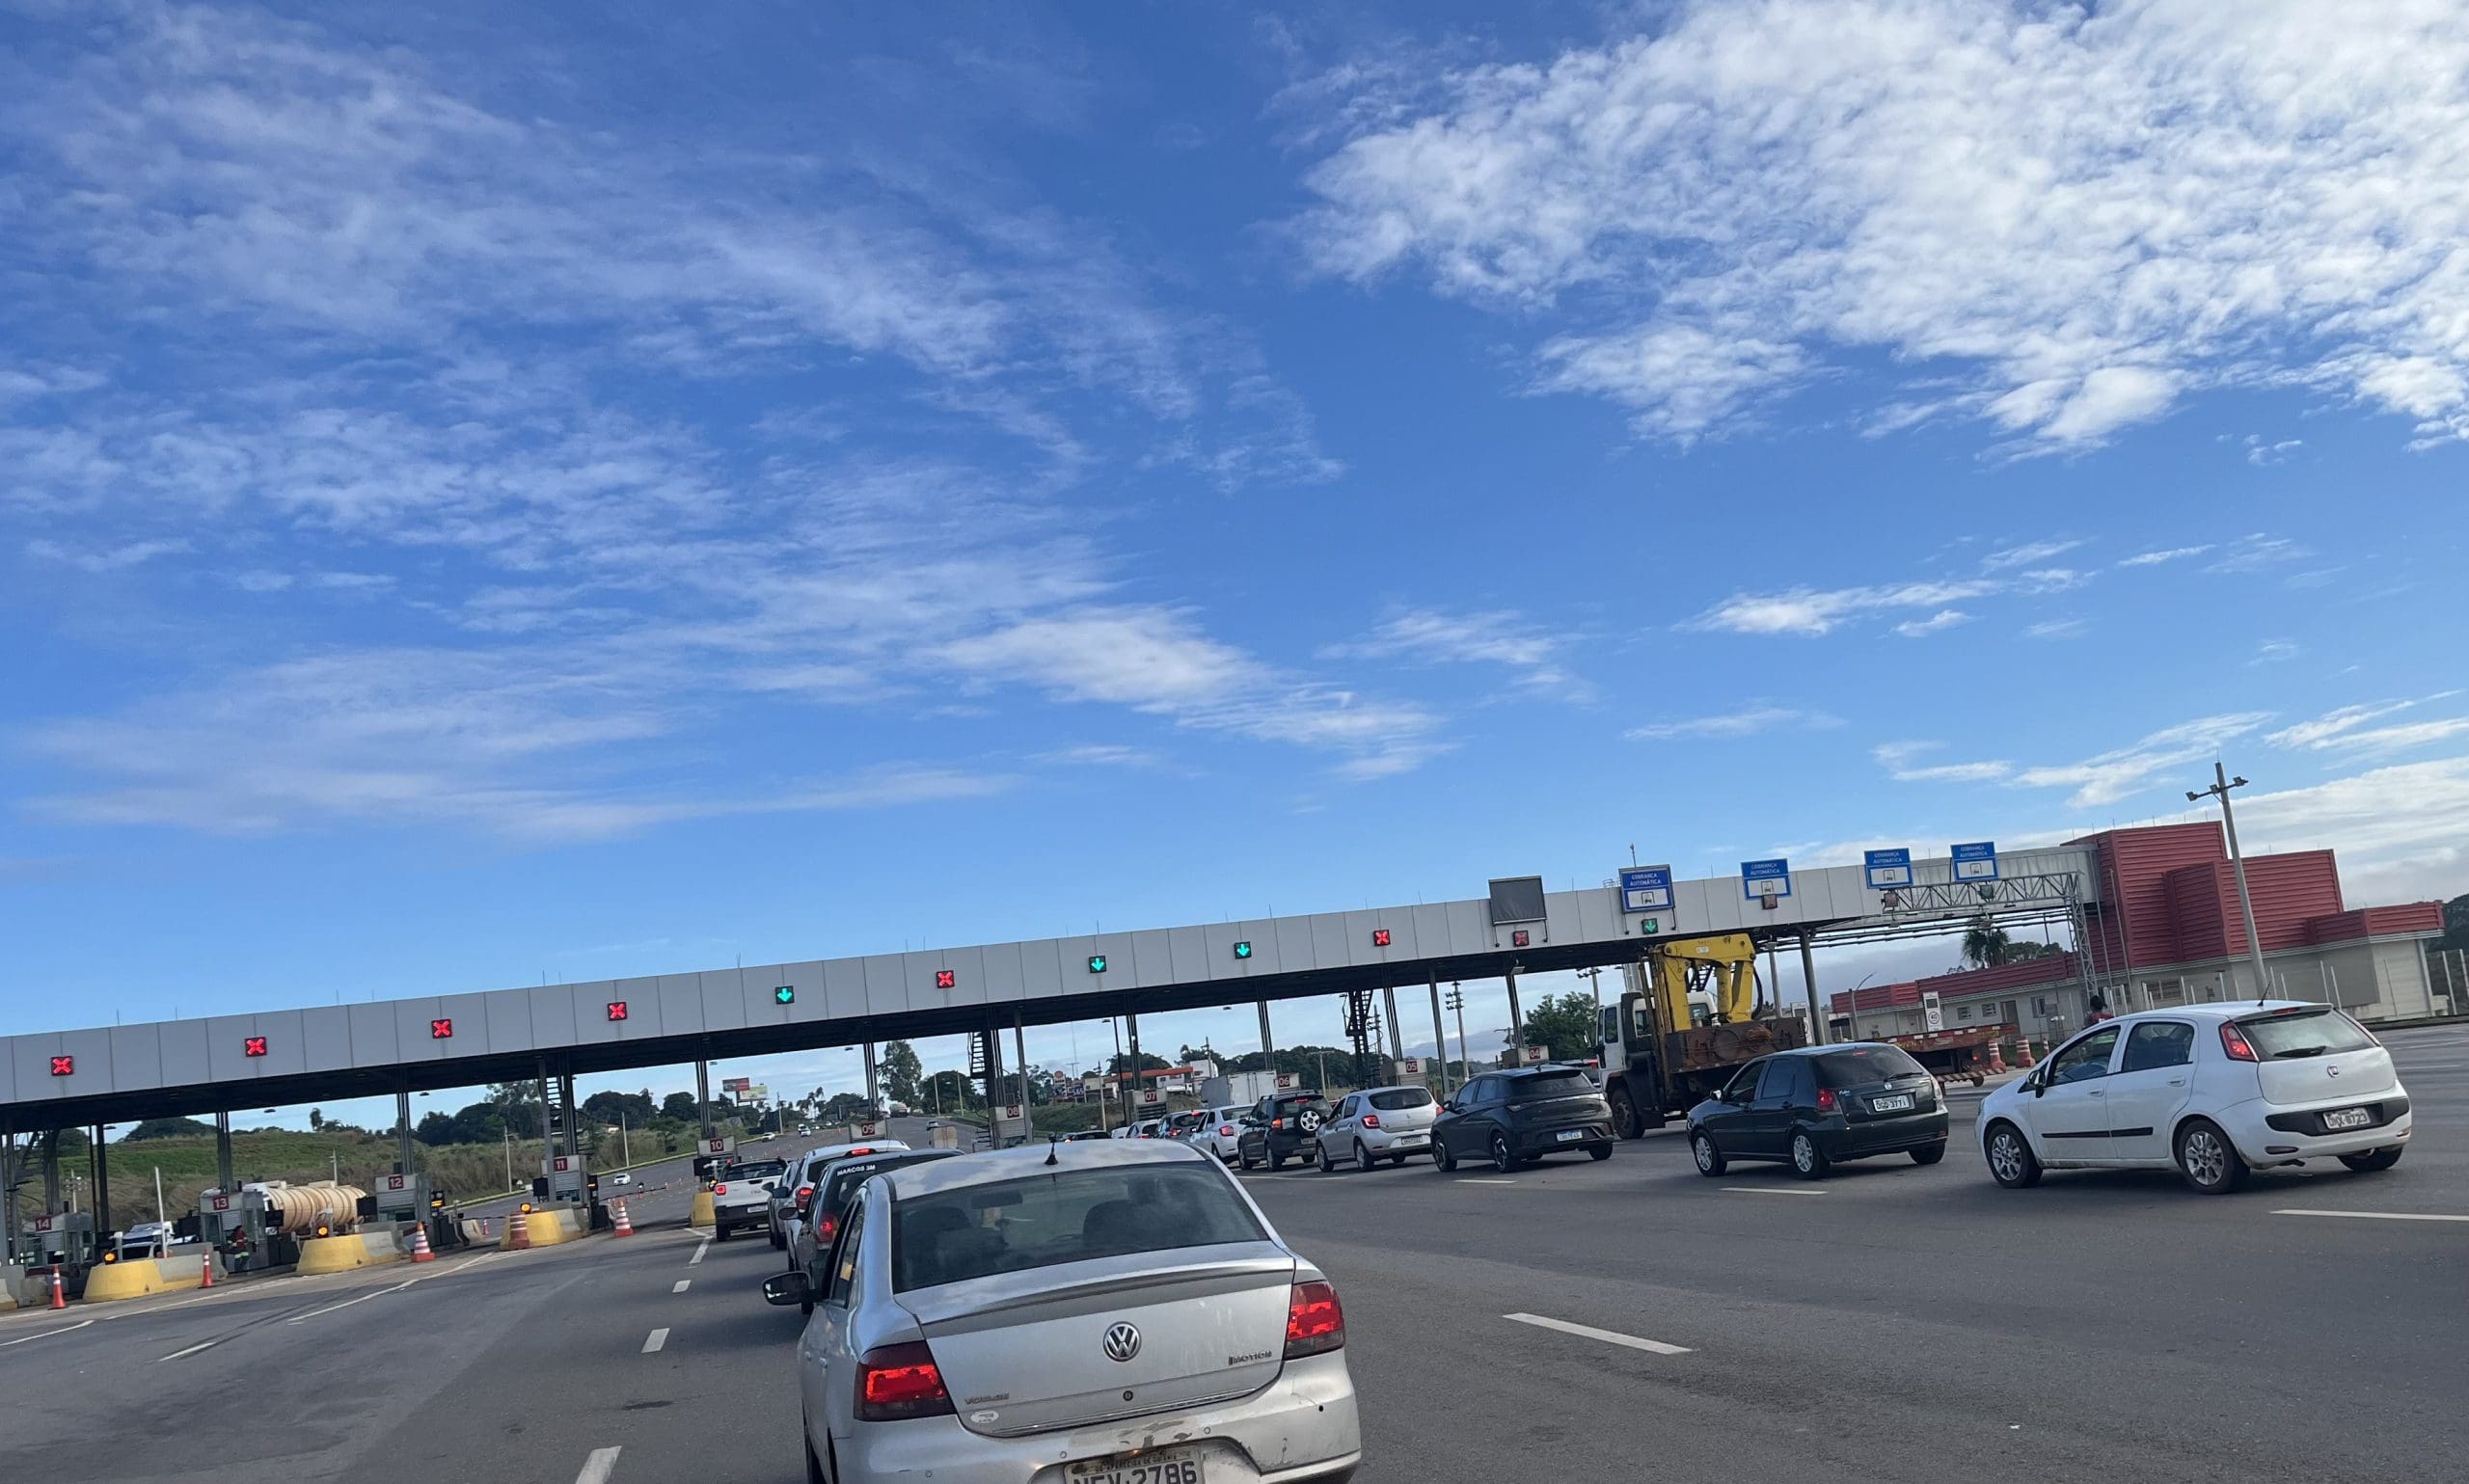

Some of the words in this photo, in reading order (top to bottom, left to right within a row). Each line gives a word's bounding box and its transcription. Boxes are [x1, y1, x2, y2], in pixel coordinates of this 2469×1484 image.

[1530, 1048, 1540, 1059] 04
[1406, 1062, 1418, 1071] 05
[1279, 1076, 1289, 1086] 06
[1145, 1091, 1156, 1101] 07
[1008, 1106, 1018, 1117] 08
[862, 1124, 874, 1134] 09
[711, 1140, 722, 1150] 10
[556, 1160, 565, 1170] 11
[390, 1177, 402, 1188] 12
[214, 1198, 228, 1208] 13
[37, 1219, 50, 1229] 14
